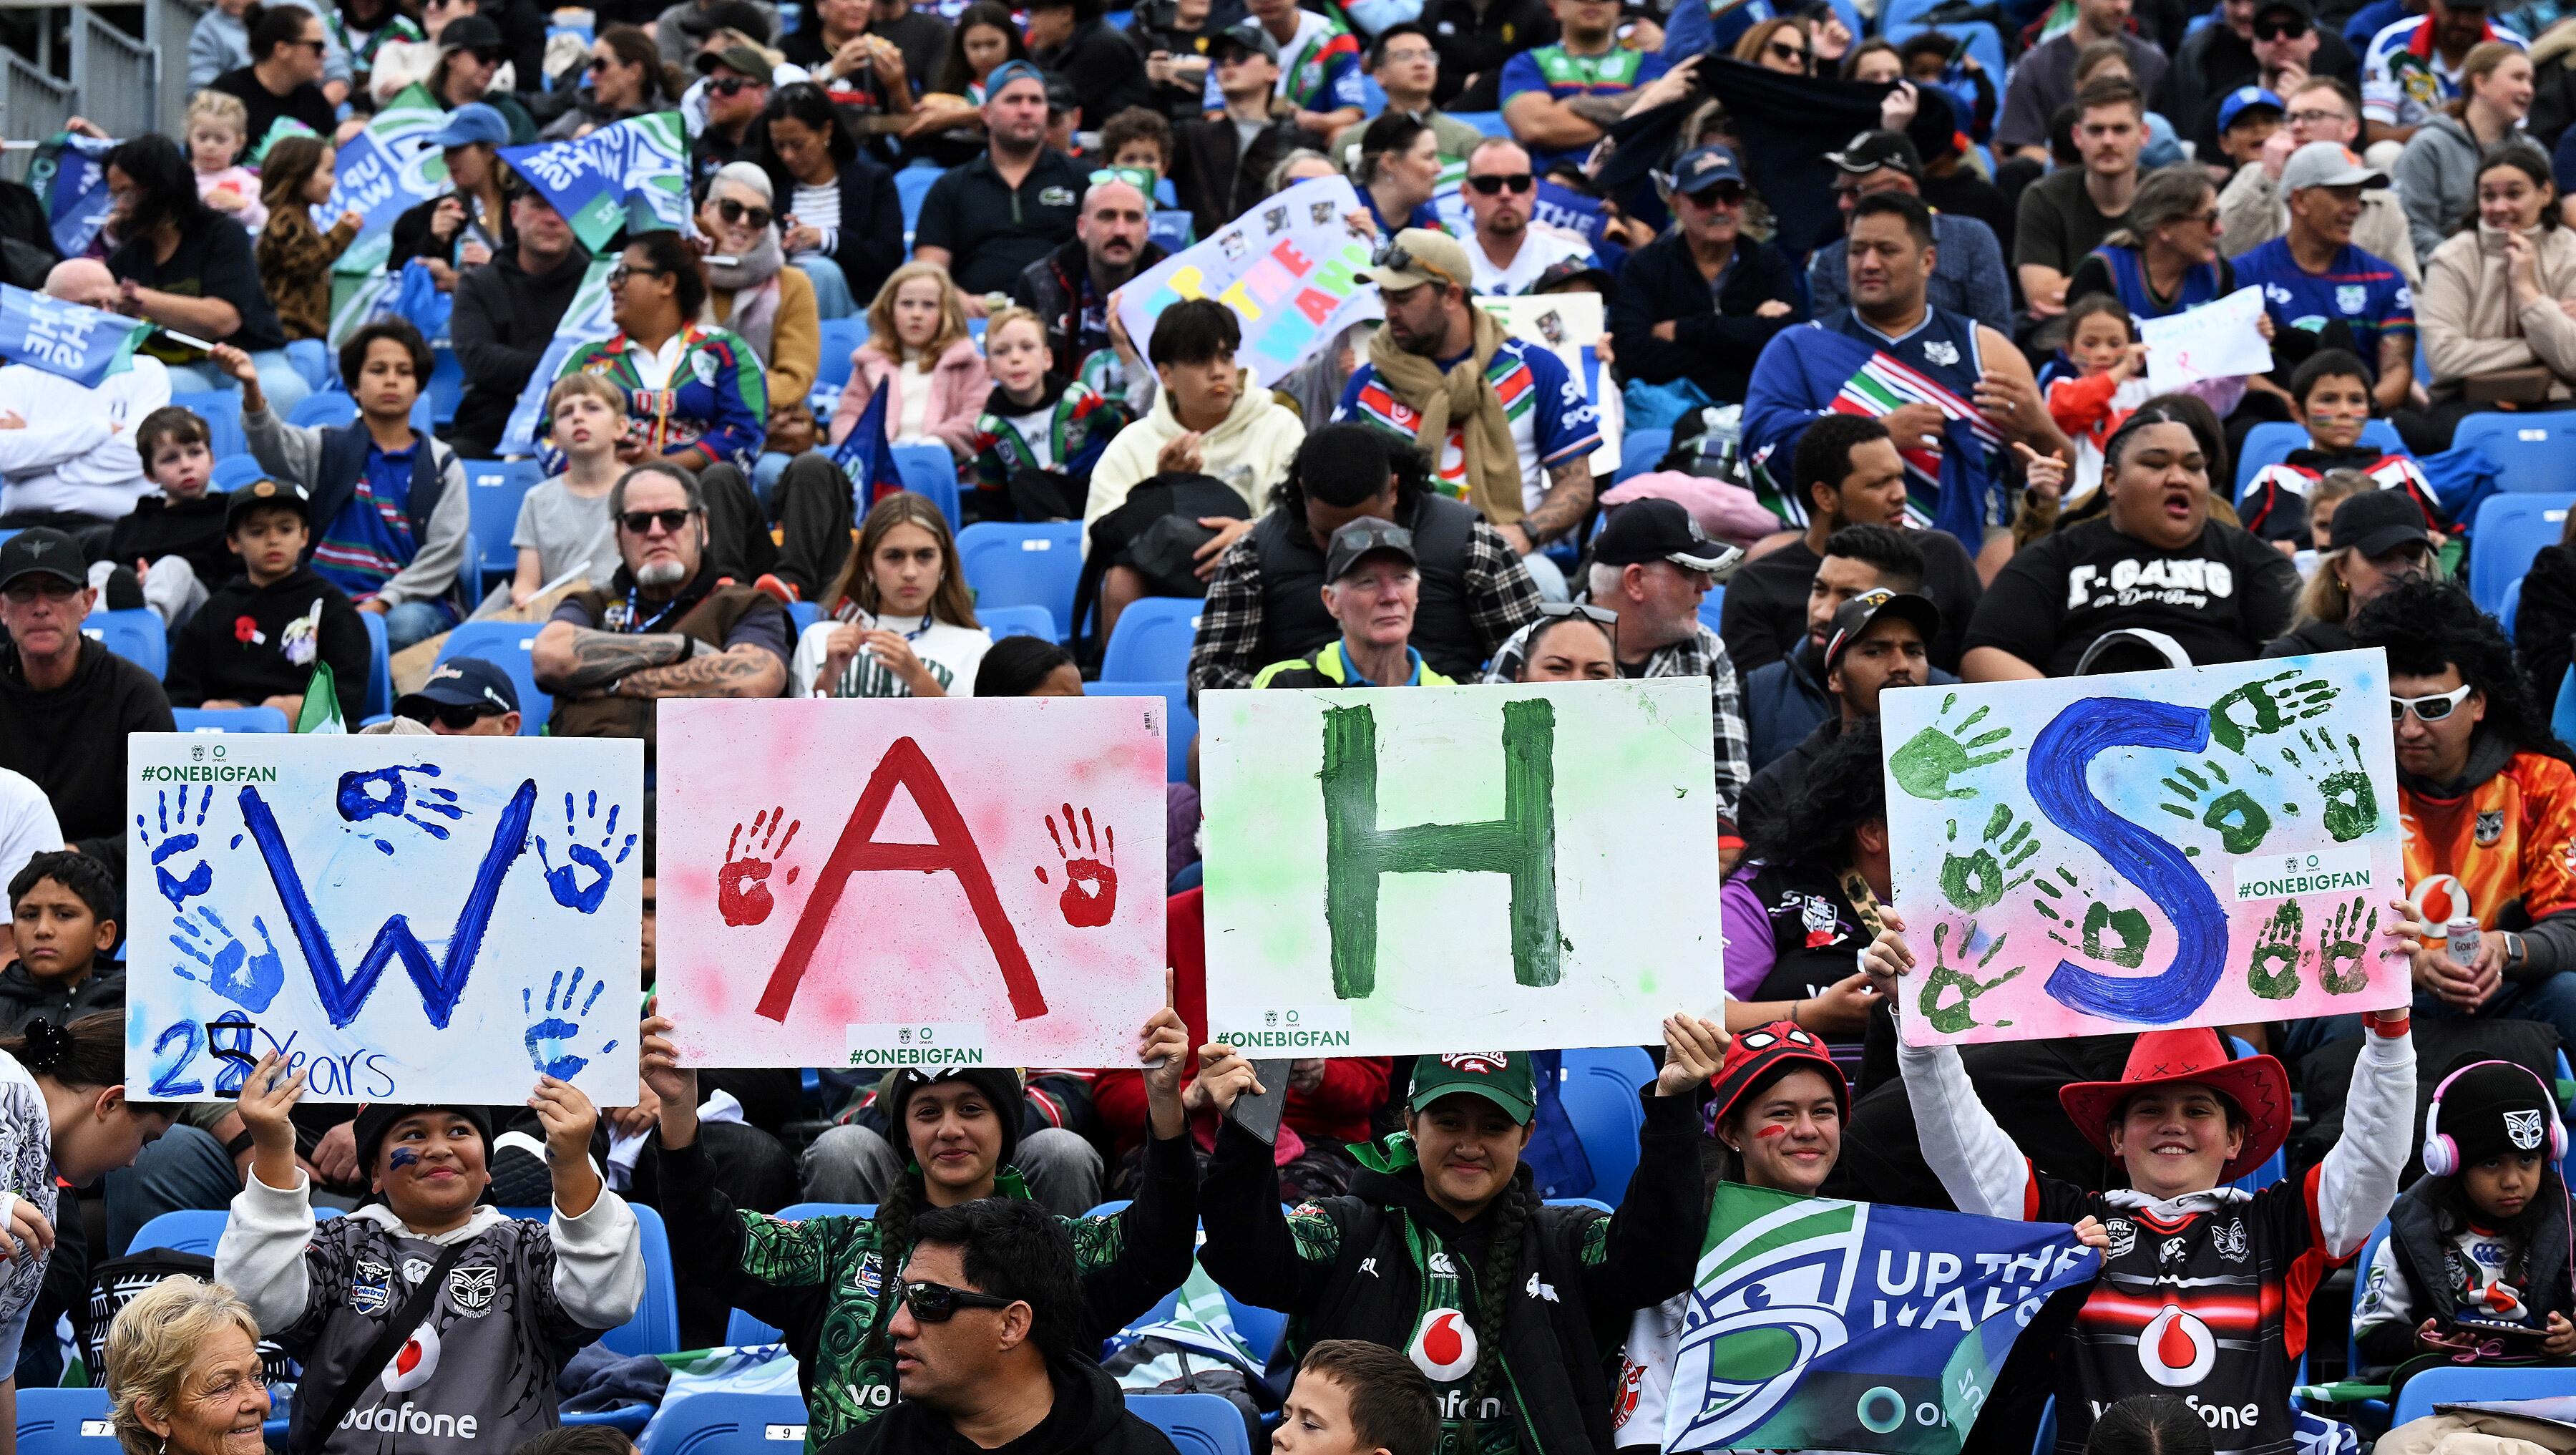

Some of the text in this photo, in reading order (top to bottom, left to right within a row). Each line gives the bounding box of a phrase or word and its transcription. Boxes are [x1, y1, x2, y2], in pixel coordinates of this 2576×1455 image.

[1217, 237, 1314, 323] THE
[141, 766, 276, 782] #ONEBIGFAN
[1321, 700, 1556, 1000] H
[2026, 696, 2229, 1024] S
[756, 736, 1049, 1024] A
[2238, 870, 2371, 898] #ONEBIGFAN
[237, 779, 537, 1031] W
[1216, 1031, 1350, 1048] #ONEBIGFAN
[258, 1026, 396, 1097] Years
[849, 1048, 982, 1064] #ONEBIGFAN
[363, 1265, 383, 1275] NRL
[2219, 1249, 2250, 1265] WARRIORS
[1876, 1249, 1963, 1298] UP
[453, 1302, 492, 1319] WARRIORS
[99, 1424, 106, 1434] 7
[337, 1401, 478, 1439] odafone
[783, 1428, 791, 1439] 9
